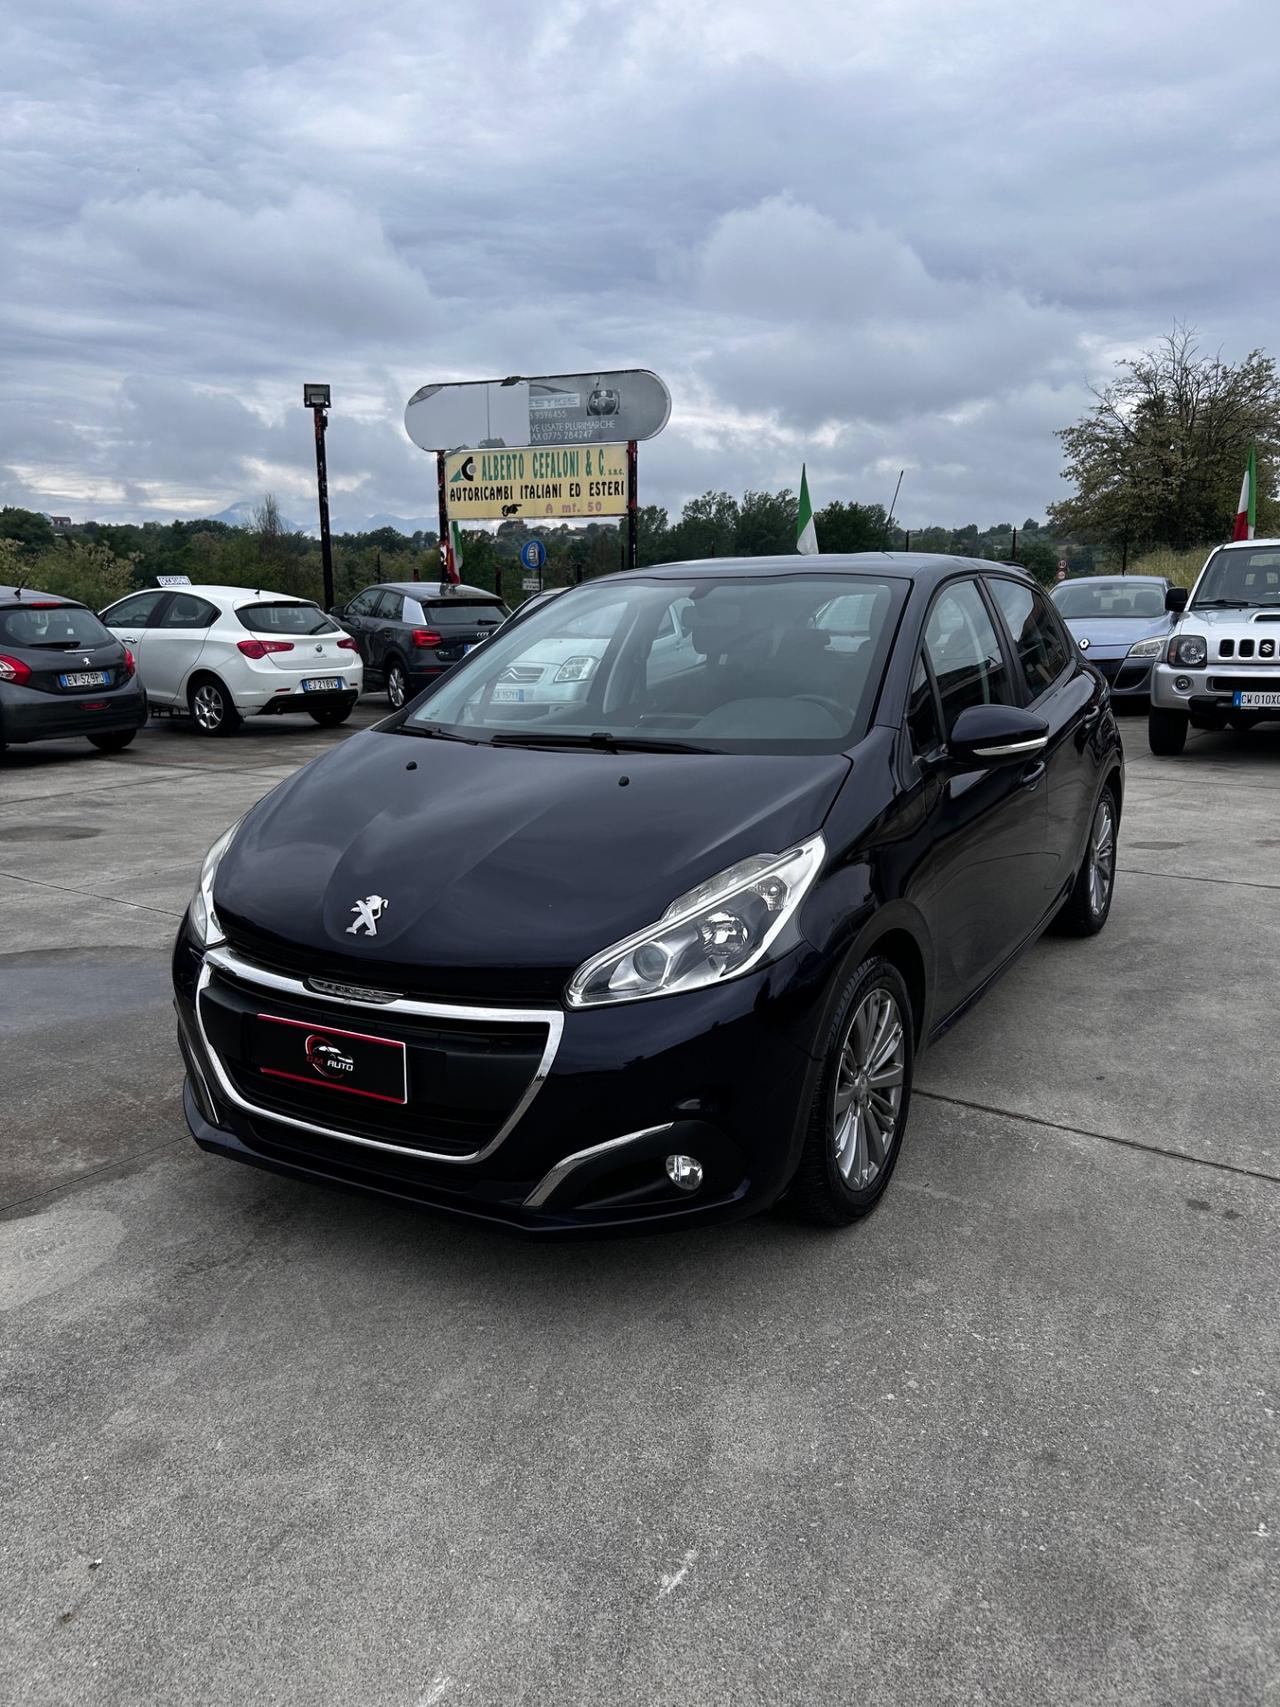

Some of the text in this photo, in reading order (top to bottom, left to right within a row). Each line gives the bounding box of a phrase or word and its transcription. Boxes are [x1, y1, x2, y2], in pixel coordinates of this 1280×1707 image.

[541, 421, 565, 432] USATE
[565, 420, 616, 431] PLURIMARCHE
[481, 453, 525, 481] ALBERTO
[532, 450, 579, 479] CEFALONI
[585, 449, 593, 477] &
[450, 480, 624, 501] AUTORICAMBI ITALIANI ED ESTERI
[587, 501, 602, 512] 50
[327, 1060, 354, 1071] AUTO
